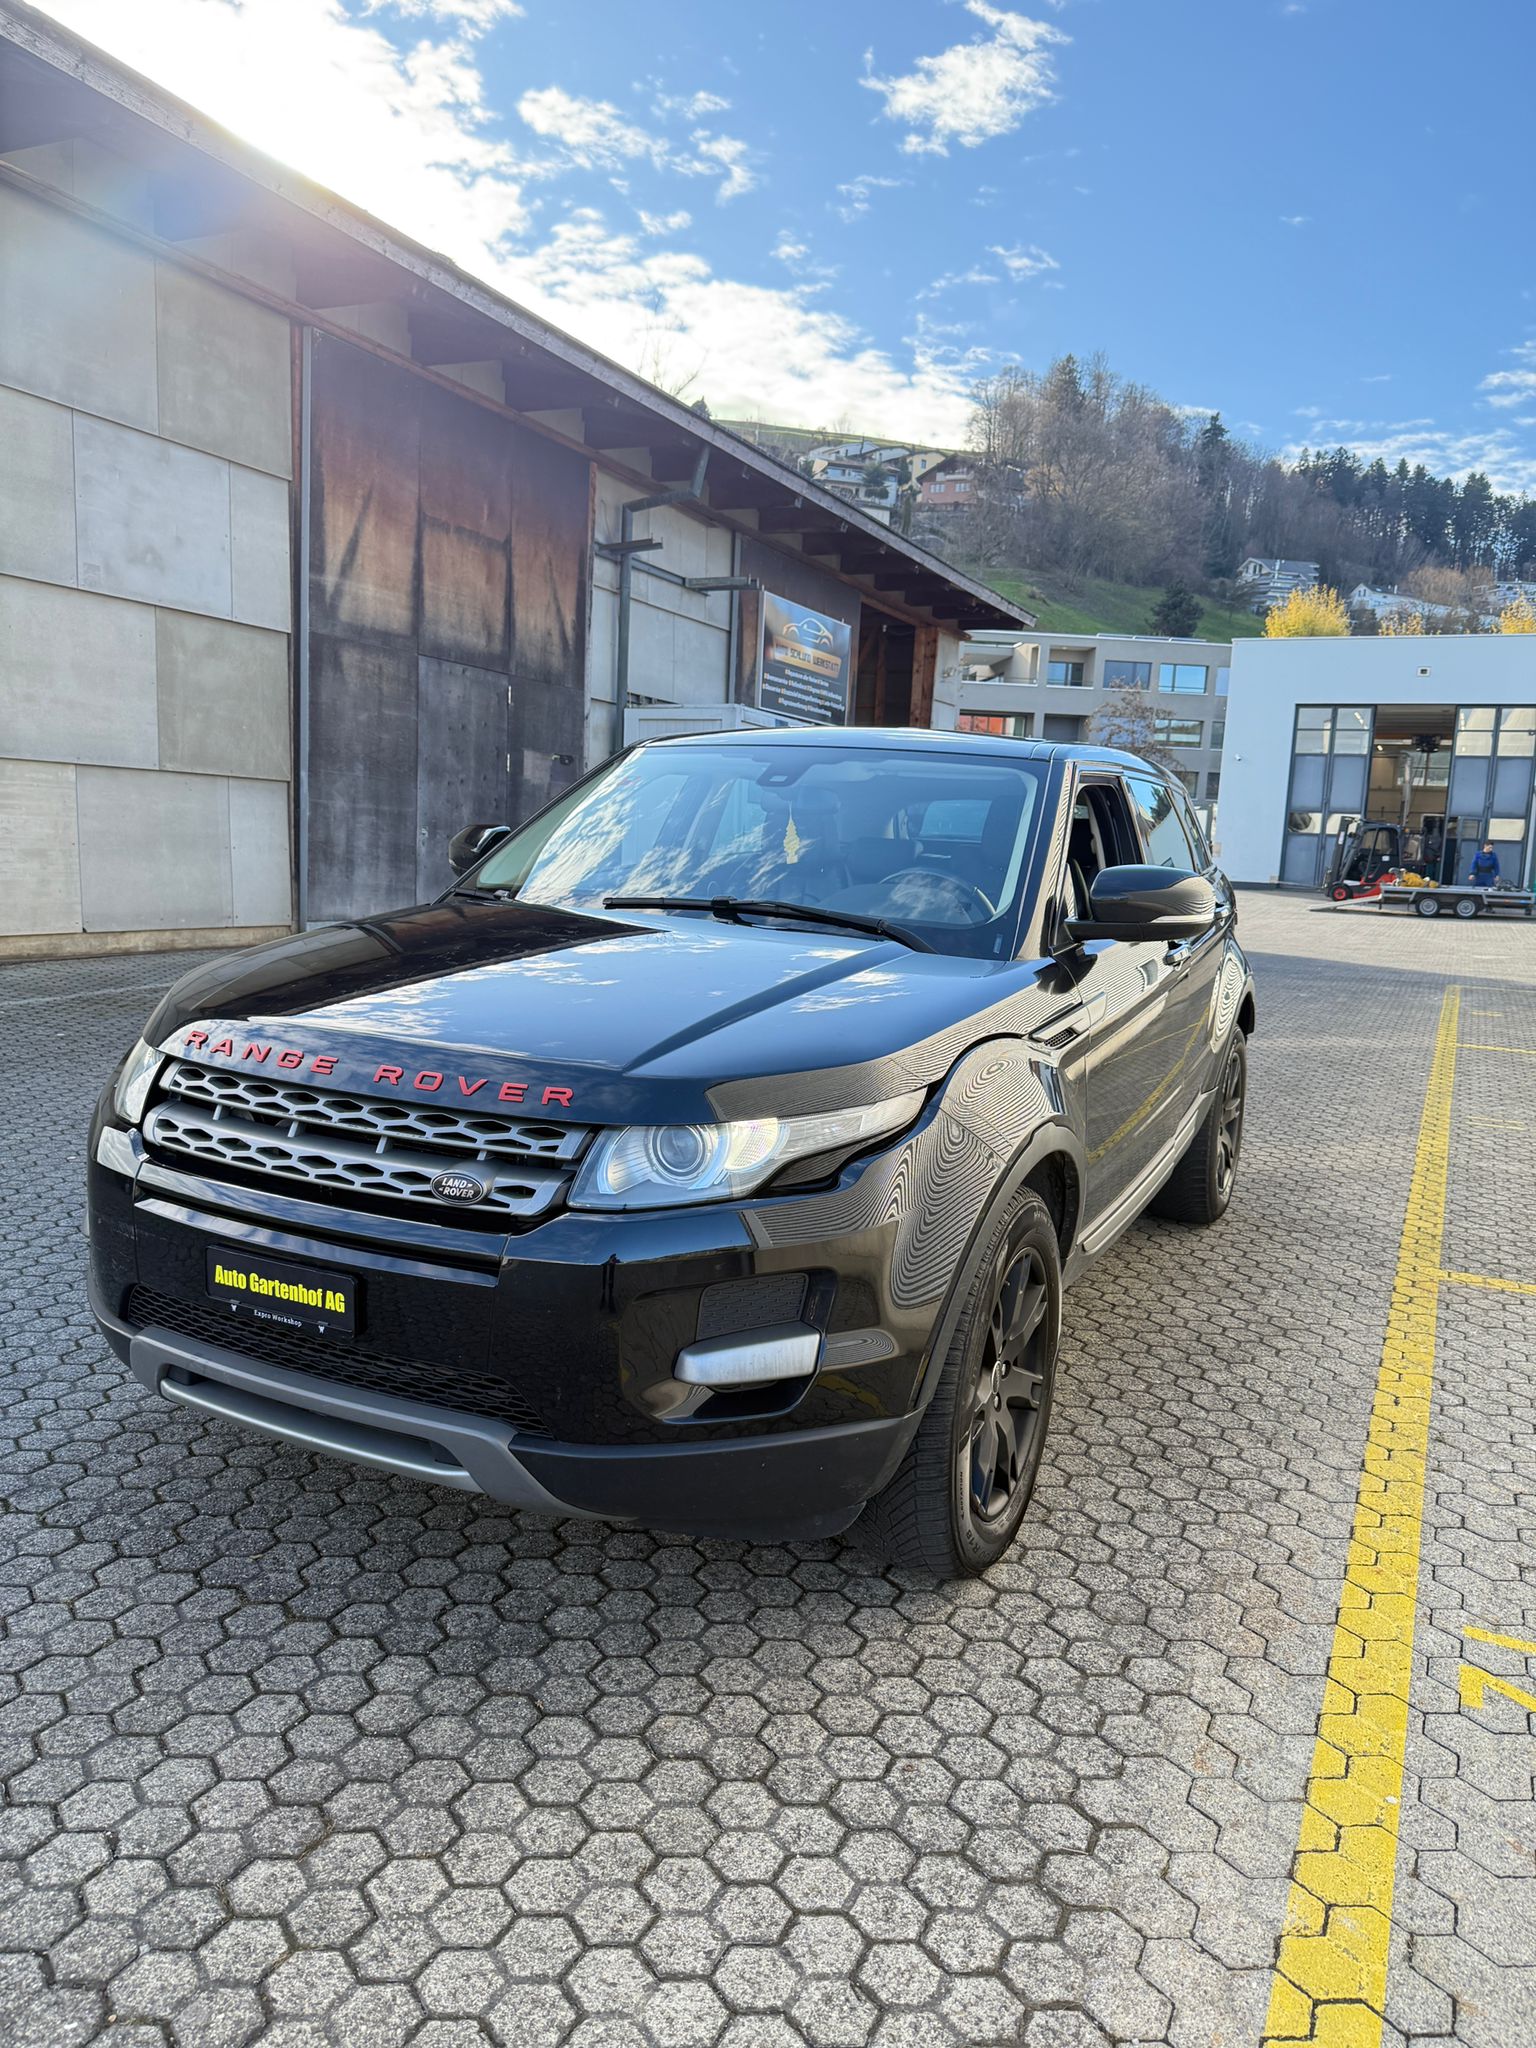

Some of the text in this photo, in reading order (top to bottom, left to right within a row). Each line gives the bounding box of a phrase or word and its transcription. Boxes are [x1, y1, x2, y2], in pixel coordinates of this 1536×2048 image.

[184, 1030, 574, 1107] RANGE ROVER
[442, 1177, 467, 1189] LAND
[443, 1187, 475, 1198] ROVER
[214, 1264, 346, 1313] Auto Gartenhof AG
[272, 1313, 302, 1328] Workshop
